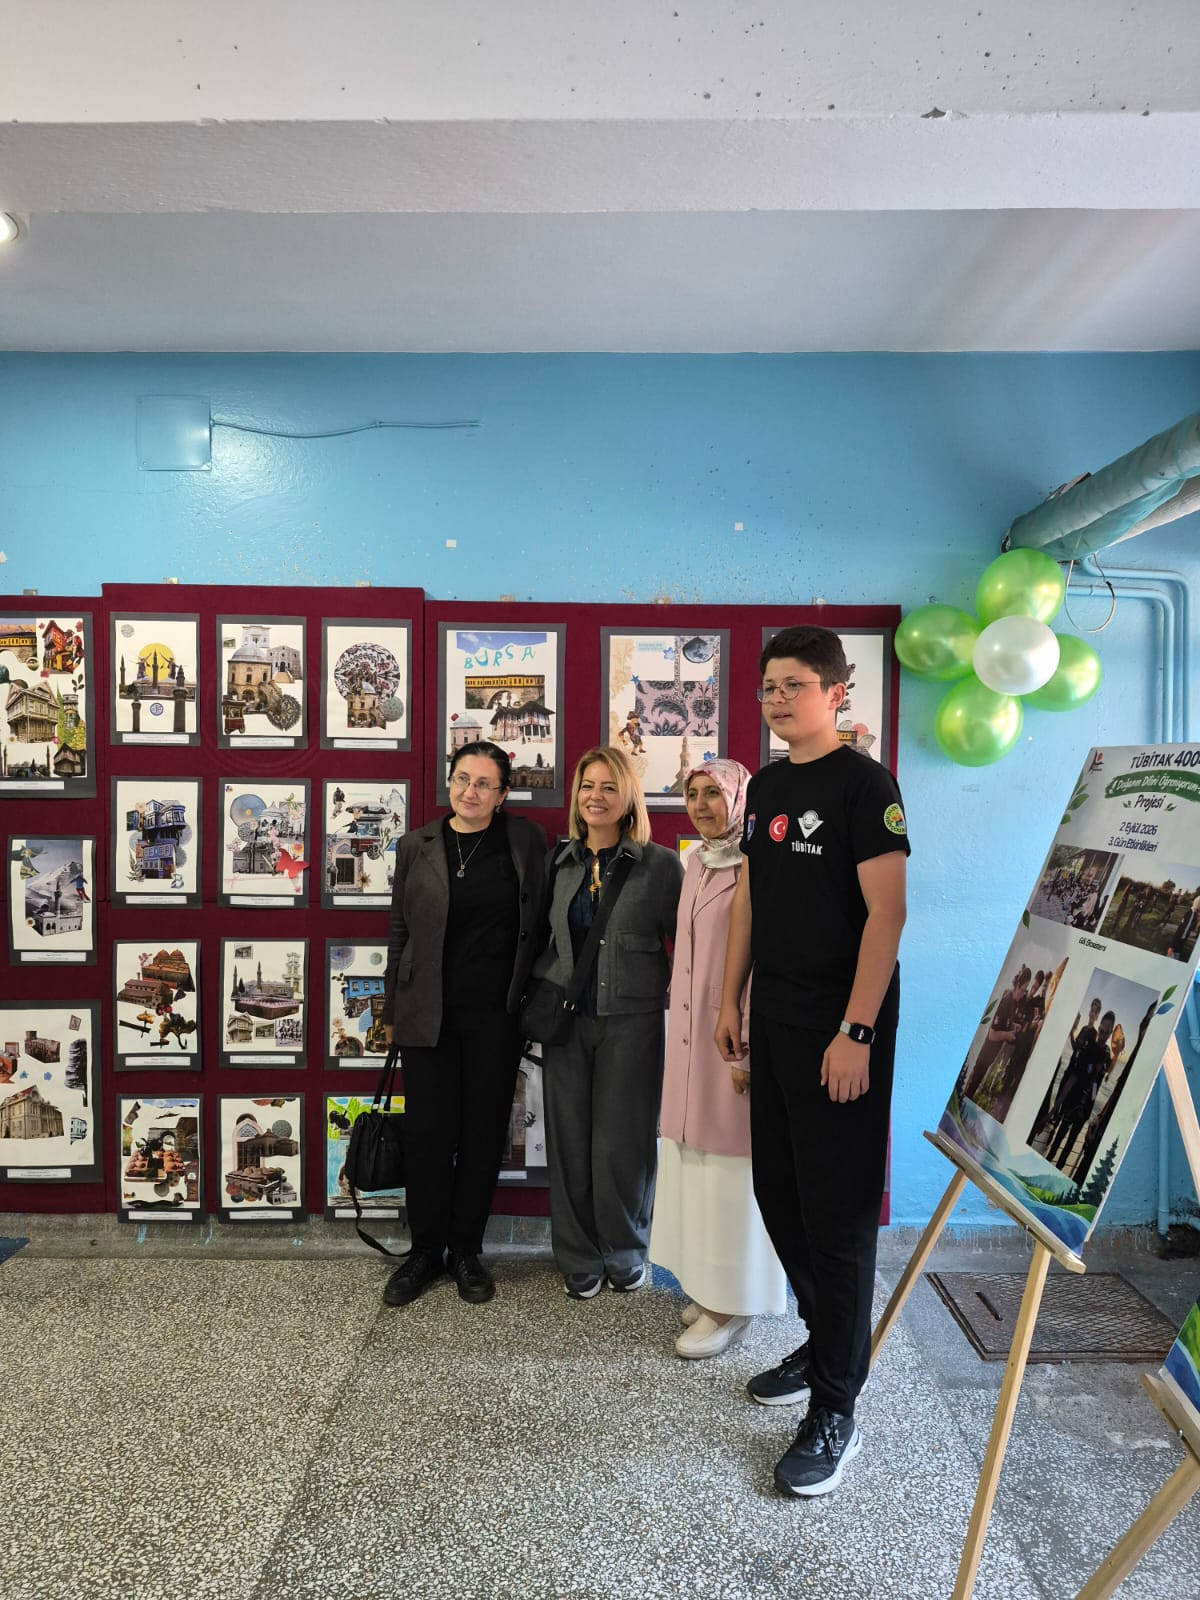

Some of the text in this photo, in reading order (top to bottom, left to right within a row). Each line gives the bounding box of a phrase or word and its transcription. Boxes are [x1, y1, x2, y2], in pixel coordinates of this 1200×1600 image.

[463, 643, 535, 669] BURSA
[1130, 750, 1200, 768] TÜBİTAK 400
[1134, 794, 1166, 812] Projesi
[1119, 821, 1126, 831] 2
[1125, 822, 1142, 835] Eylül
[791, 840, 823, 855] TÜBİTAK
[1113, 837, 1127, 848] Gün
